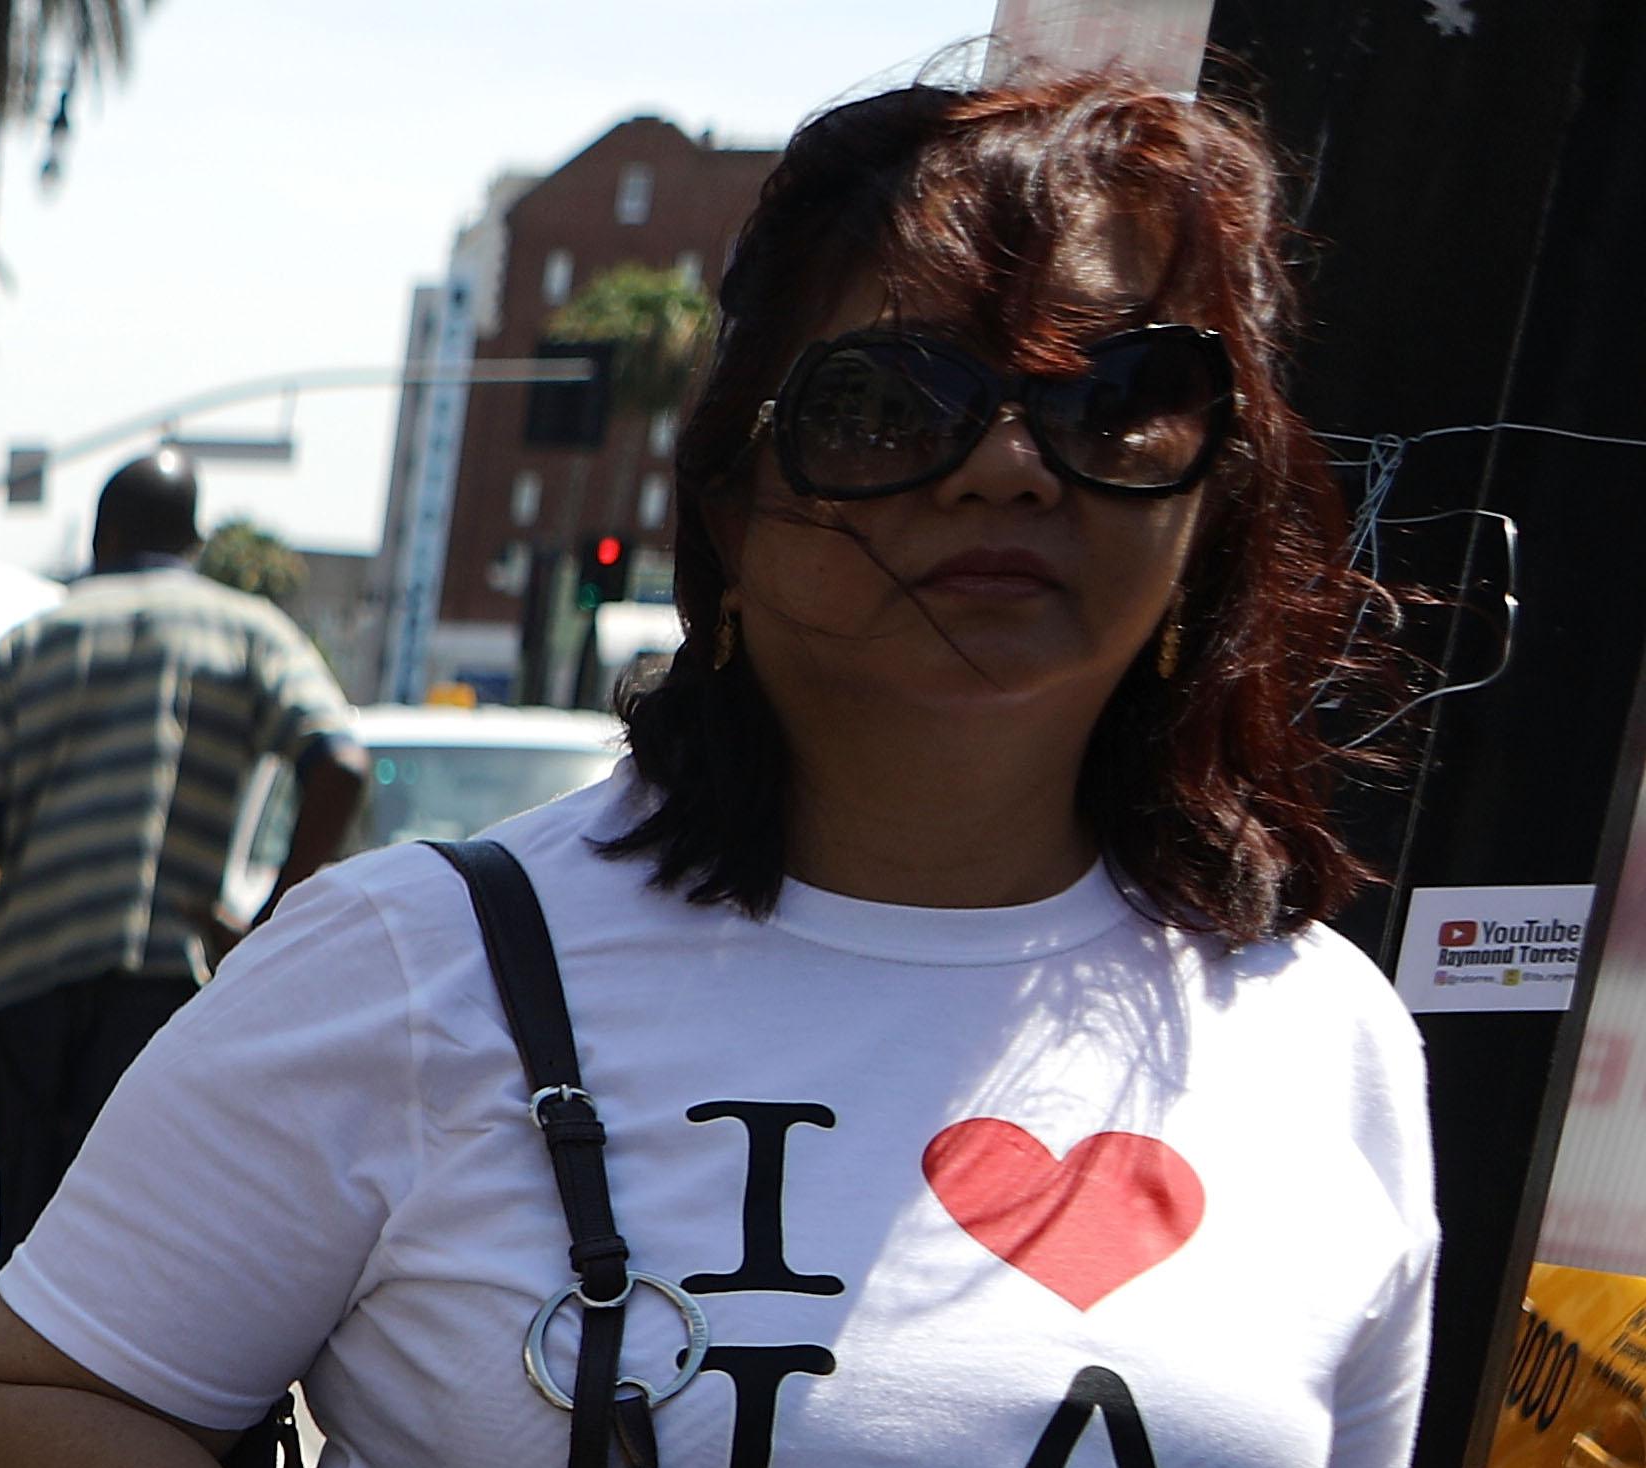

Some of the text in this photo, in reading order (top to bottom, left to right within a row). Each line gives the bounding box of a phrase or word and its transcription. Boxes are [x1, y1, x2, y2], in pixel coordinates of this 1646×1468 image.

[1482, 918, 1582, 945] YouTube
[1437, 944, 1580, 969] Raymond Torres
[680, 1100, 845, 1296] I
